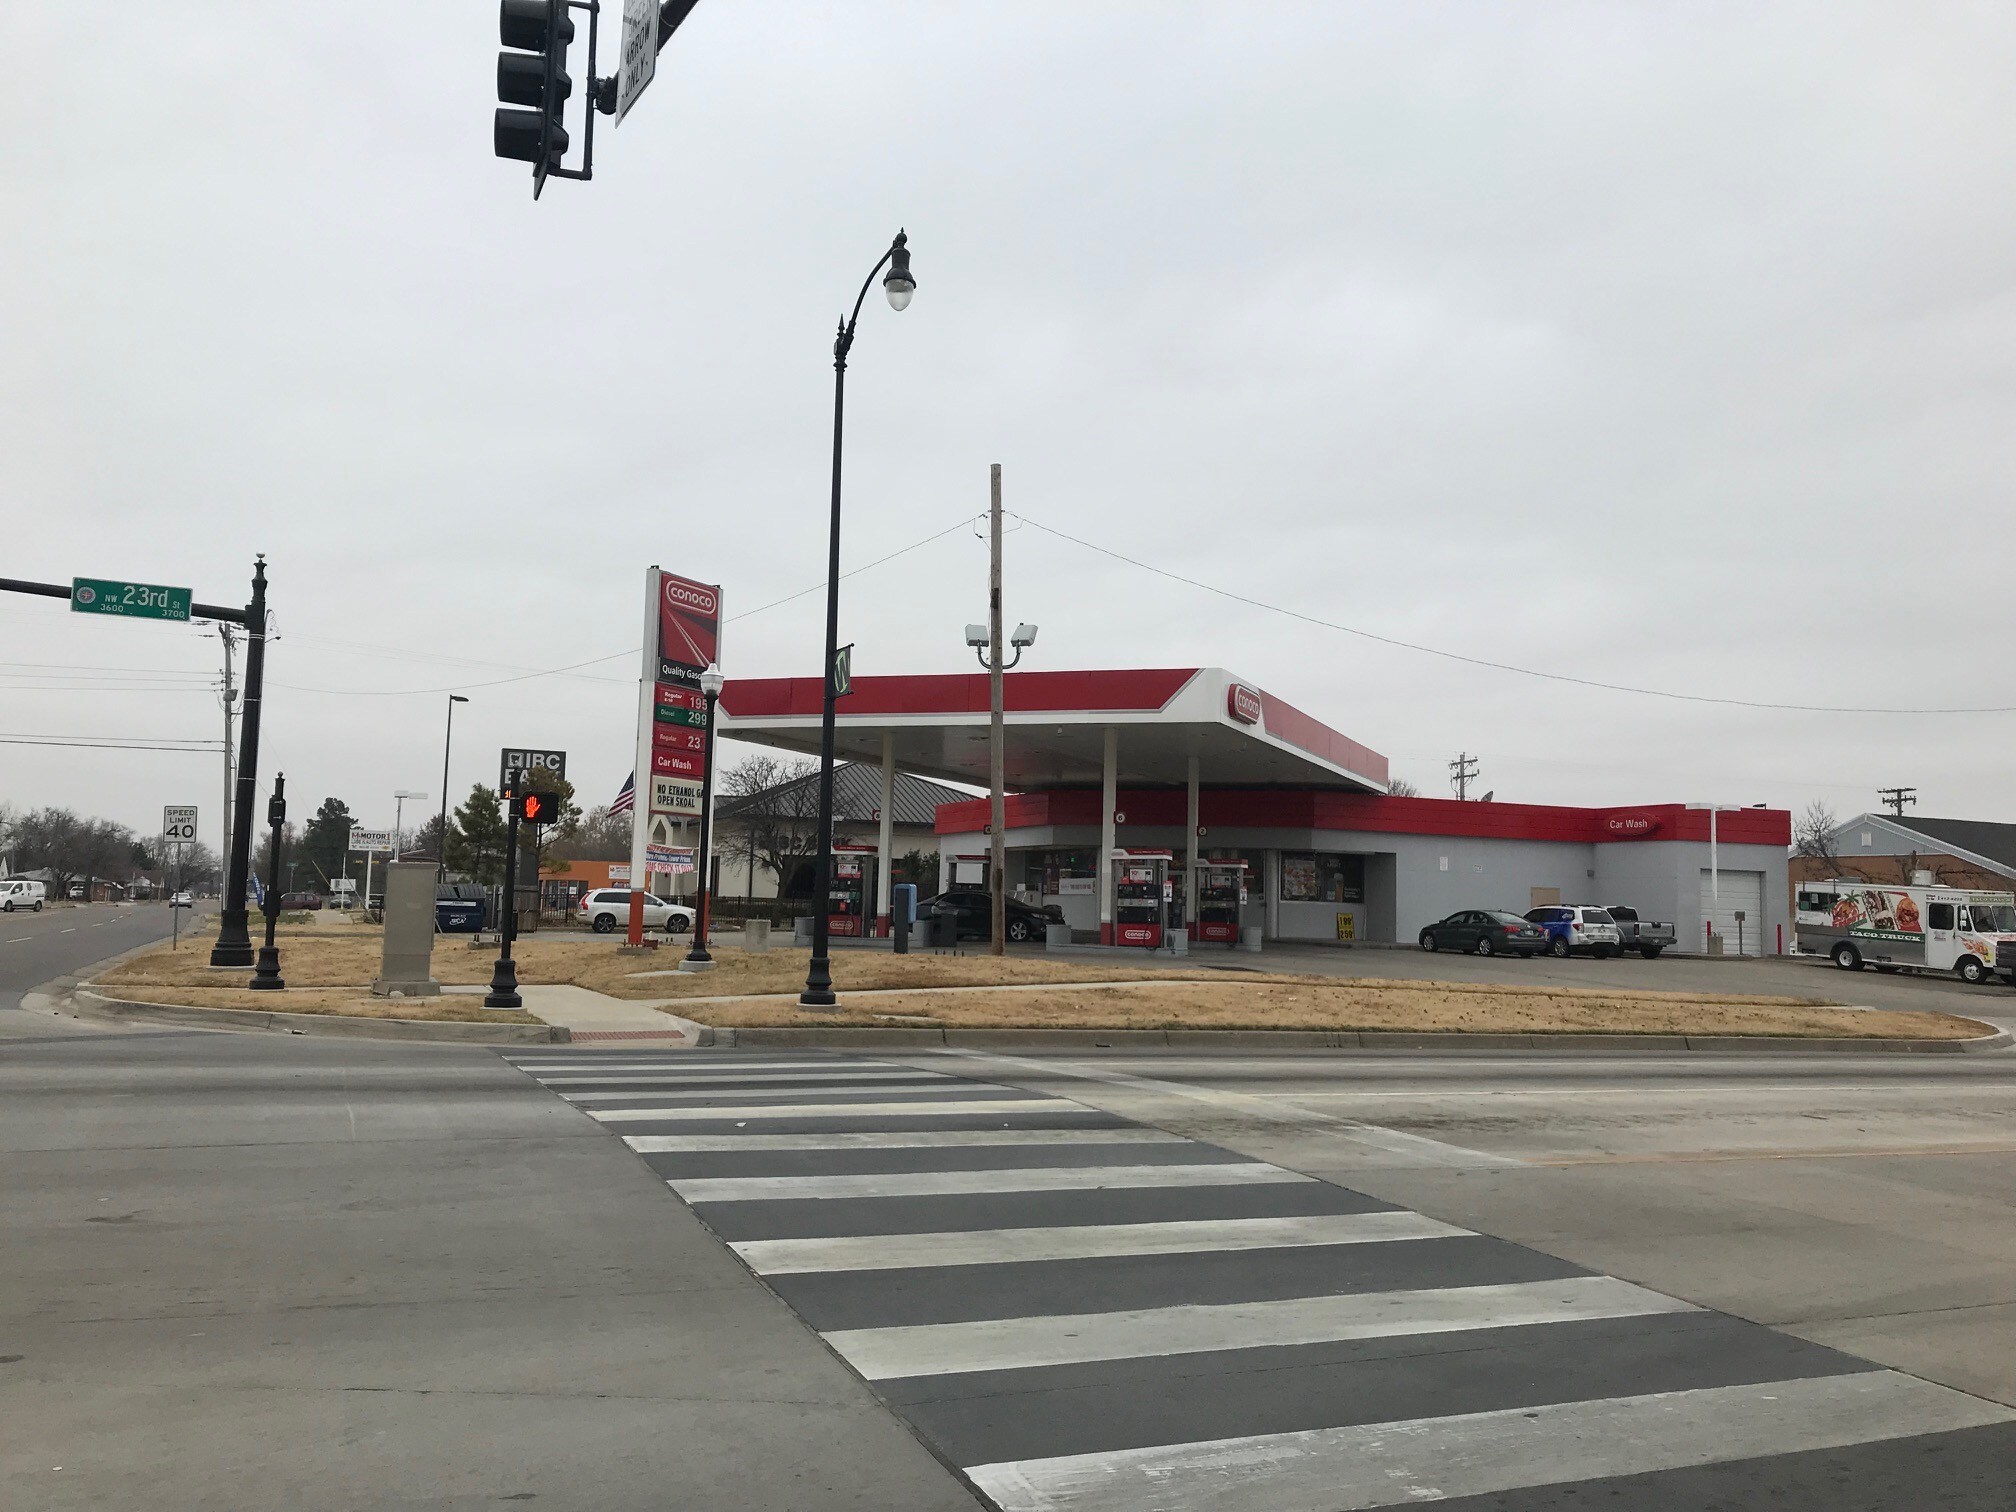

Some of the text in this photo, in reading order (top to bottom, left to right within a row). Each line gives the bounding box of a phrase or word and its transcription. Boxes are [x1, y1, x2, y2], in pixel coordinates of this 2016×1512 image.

[626, 16, 651, 67] ARROW
[626, 53, 645, 97] ONLY
[104, 584, 181, 609] NW 23rd St
[100, 603, 124, 613] 3600
[161, 609, 185, 618] 3700
[662, 664, 703, 680] Quality Gaso
[664, 691, 708, 711] Regular 195
[660, 708, 707, 726] Diesel 299
[660, 733, 701, 749] Regular 23
[657, 756, 692, 770] Car Wash
[657, 784, 667, 794] NO
[668, 785, 696, 798] ETHANOL
[657, 795, 696, 808] OPEN SKOAL
[1609, 818, 1648, 829] Car Wash
[165, 824, 194, 838] 40
[1849, 930, 1921, 942] TACO TRUCK
